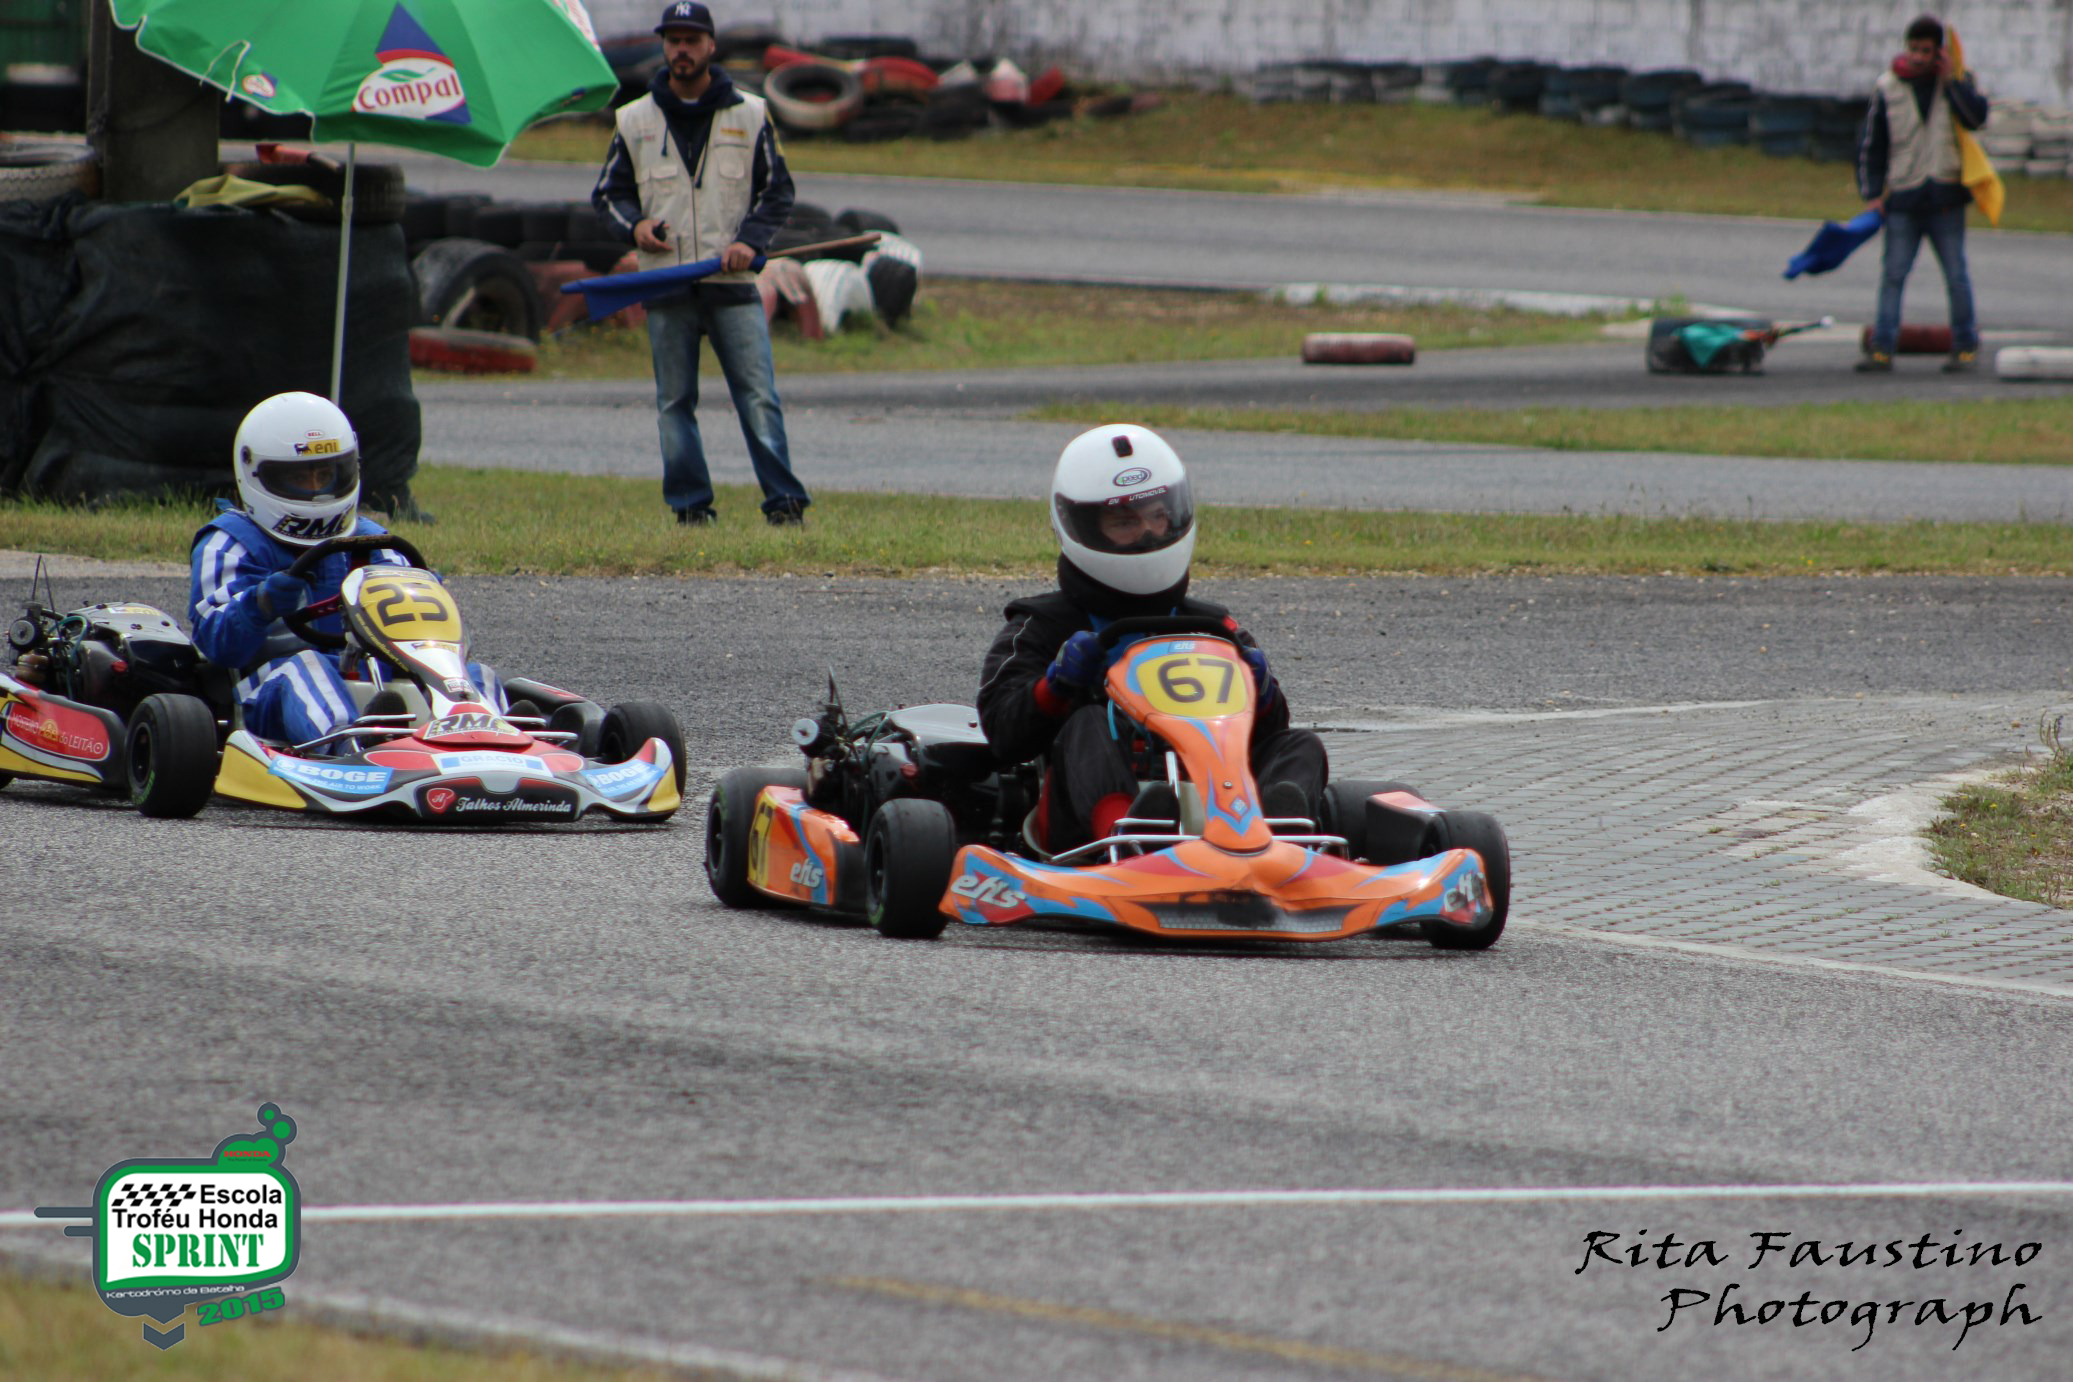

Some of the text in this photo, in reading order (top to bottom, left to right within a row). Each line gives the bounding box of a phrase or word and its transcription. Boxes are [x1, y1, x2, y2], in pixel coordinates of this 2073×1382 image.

[357, 73, 462, 111] Compal
[314, 441, 338, 454] eni
[366, 582, 448, 627] 25
[1157, 657, 1235, 704] 67
[297, 764, 387, 782] BOGE
[456, 797, 572, 813] Talhos Almerinda
